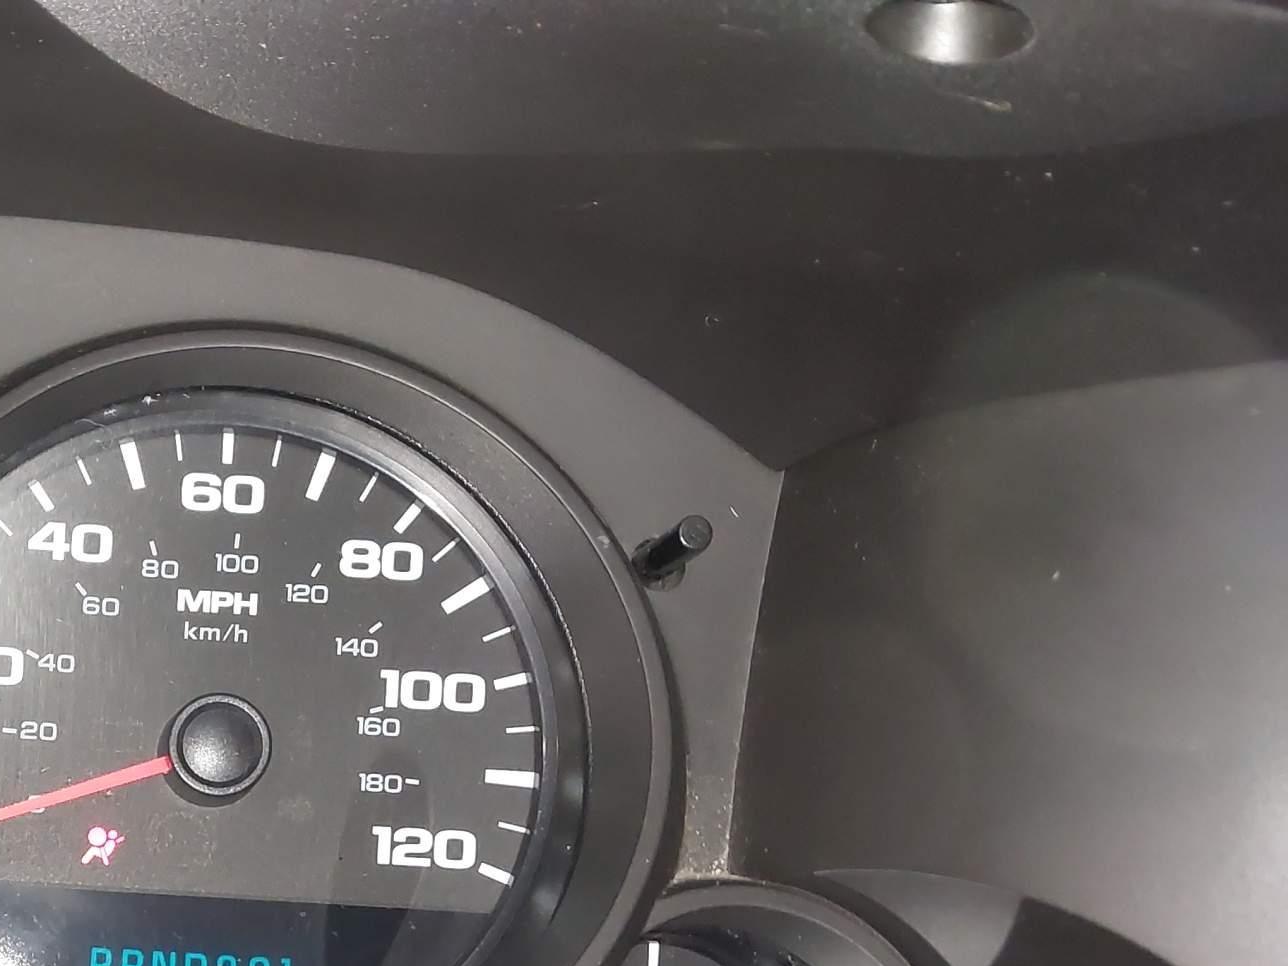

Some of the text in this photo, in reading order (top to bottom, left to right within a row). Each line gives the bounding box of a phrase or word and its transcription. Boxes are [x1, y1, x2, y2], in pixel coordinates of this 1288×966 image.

[181, 472, 266, 514] 60
[27, 521, 113, 563] 40
[140, 558, 180, 580] 80
[214, 552, 260, 575] 100
[338, 538, 424, 582] 80
[176, 588, 259, 617] MPH
[284, 583, 330, 604] 120
[81, 595, 121, 617] 60
[183, 621, 249, 644] km/h
[335, 636, 380, 658] 140
[38, 653, 76, 674] 40
[380, 669, 486, 713] 100
[19, 721, 58, 742] 20
[356, 716, 401, 737] 160
[358, 773, 403, 794] 180
[372, 825, 477, 871] 120
